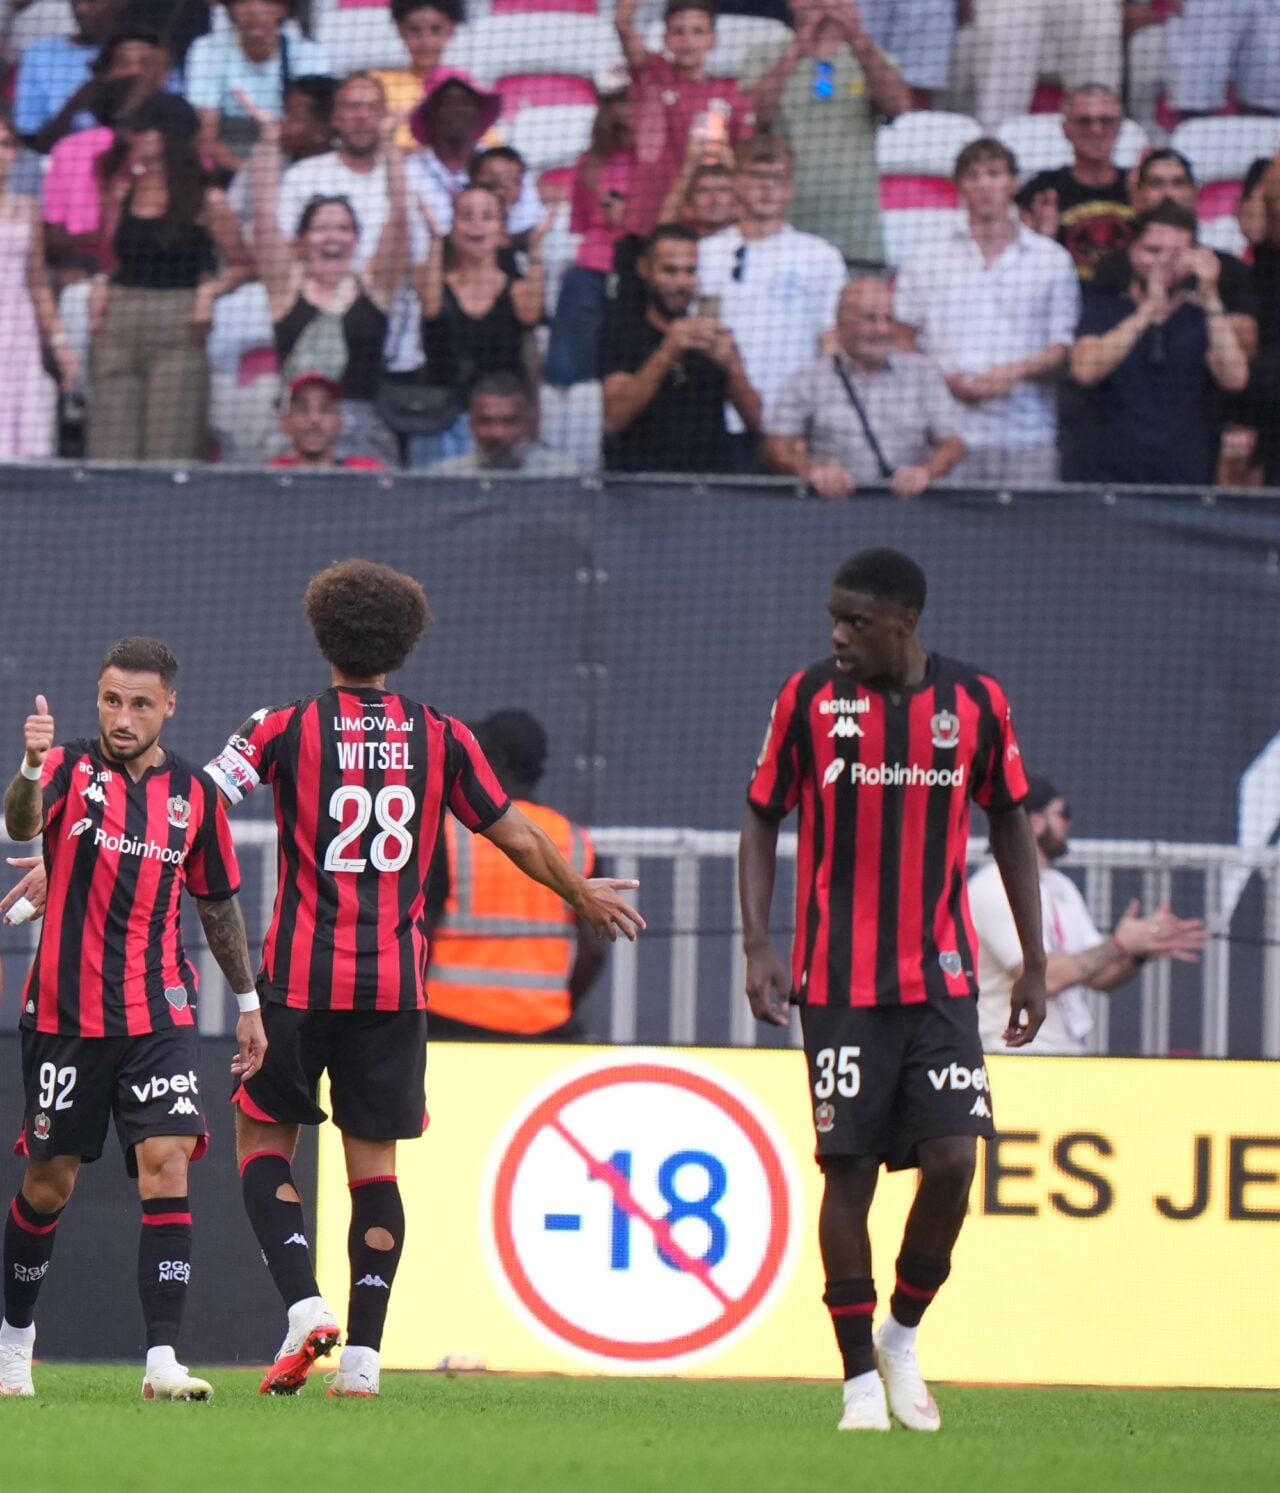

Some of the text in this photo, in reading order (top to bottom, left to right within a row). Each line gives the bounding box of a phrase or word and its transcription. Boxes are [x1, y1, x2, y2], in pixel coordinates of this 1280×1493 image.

[819, 696, 871, 714] actual
[333, 716, 414, 732] LIMOVA.ai
[227, 734, 257, 757] EOS
[337, 742, 414, 771] WITSEL
[78, 761, 113, 782] acal
[851, 763, 964, 787] Robinhood
[324, 785, 416, 873] 28
[93, 827, 190, 865] Robinhood
[38, 1061, 78, 1112] 92
[131, 1070, 199, 1103] vbet
[814, 1046, 862, 1099] 35
[967, 1130, 1116, 1219] ES
